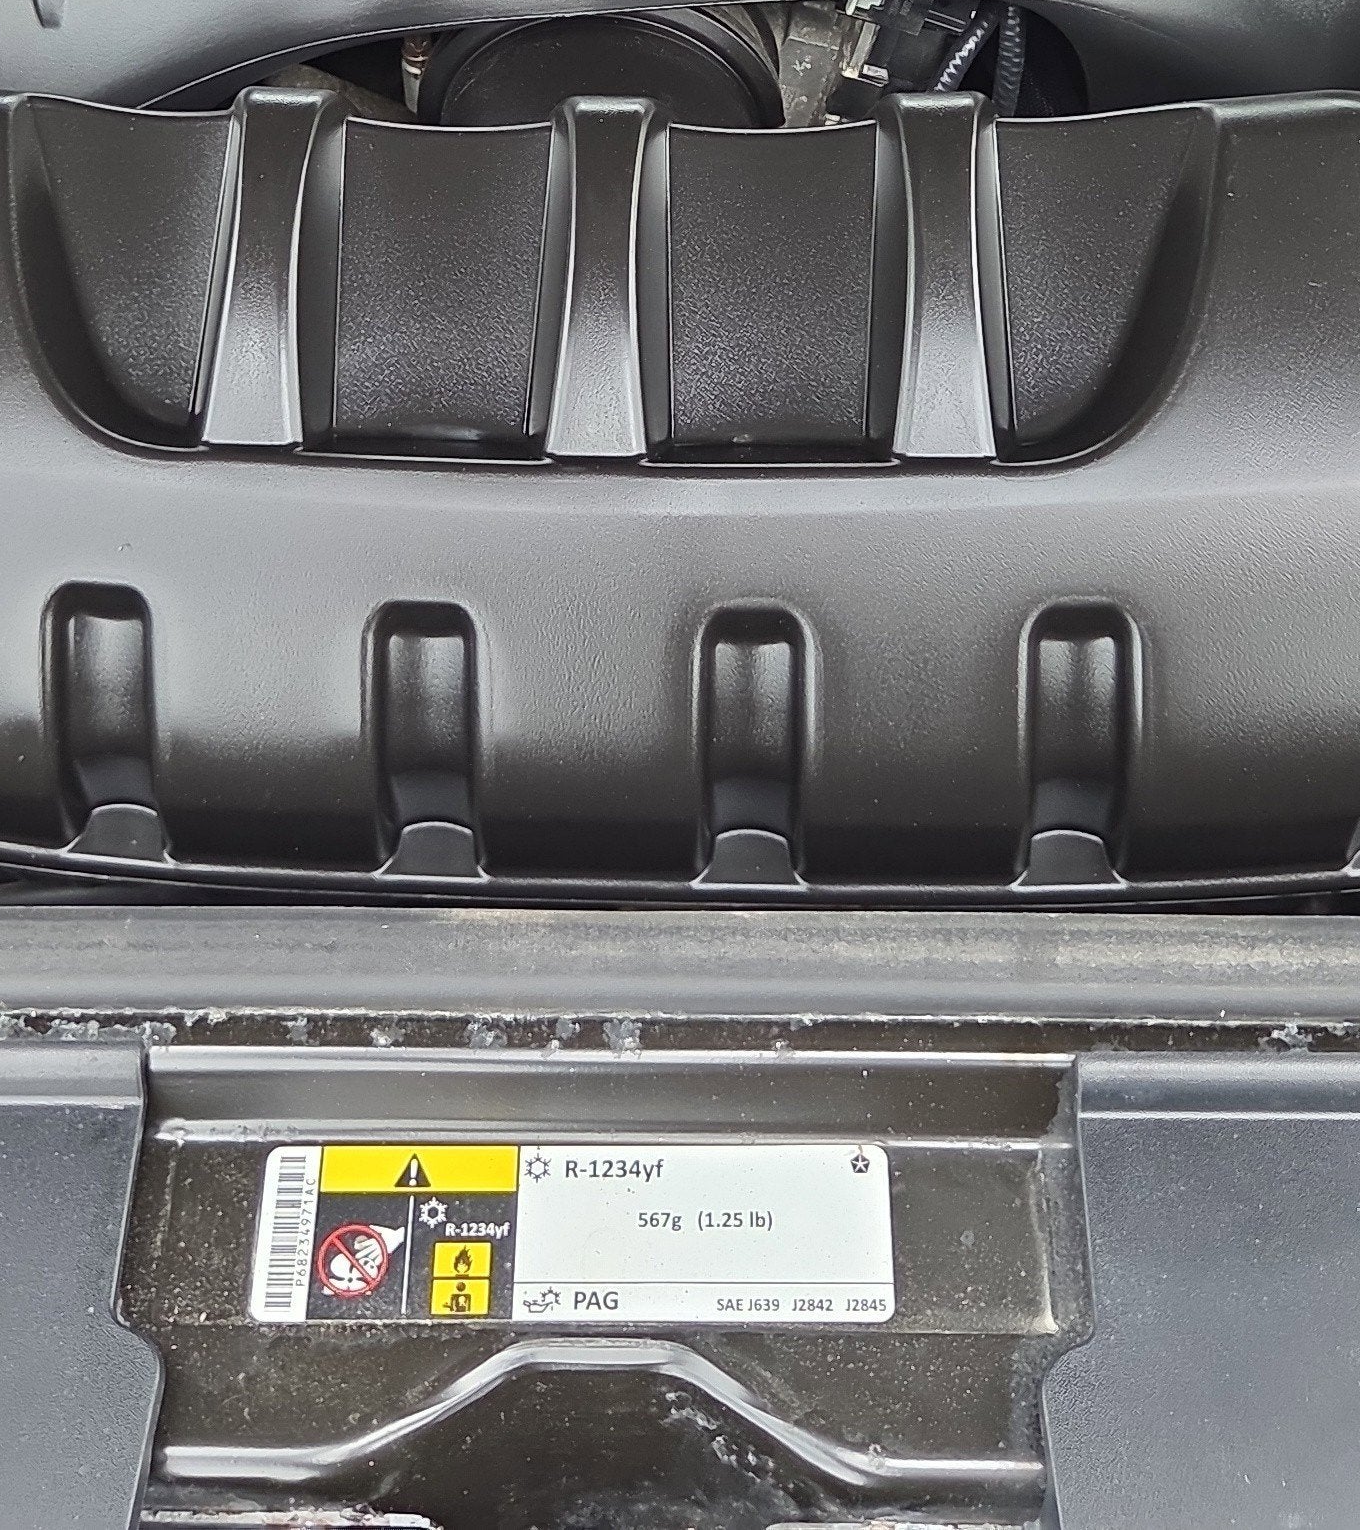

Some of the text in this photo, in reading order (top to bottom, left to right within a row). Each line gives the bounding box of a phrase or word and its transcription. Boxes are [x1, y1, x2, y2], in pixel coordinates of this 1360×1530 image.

[565, 1158, 664, 1183] R-1234yf
[445, 1221, 511, 1240] R-1234yf
[637, 1210, 774, 1231] 567g (1.25 lb)
[295, 1178, 317, 1287] P68234971AC
[573, 1290, 887, 1313] PAG SAE J639 J2842 J2845
